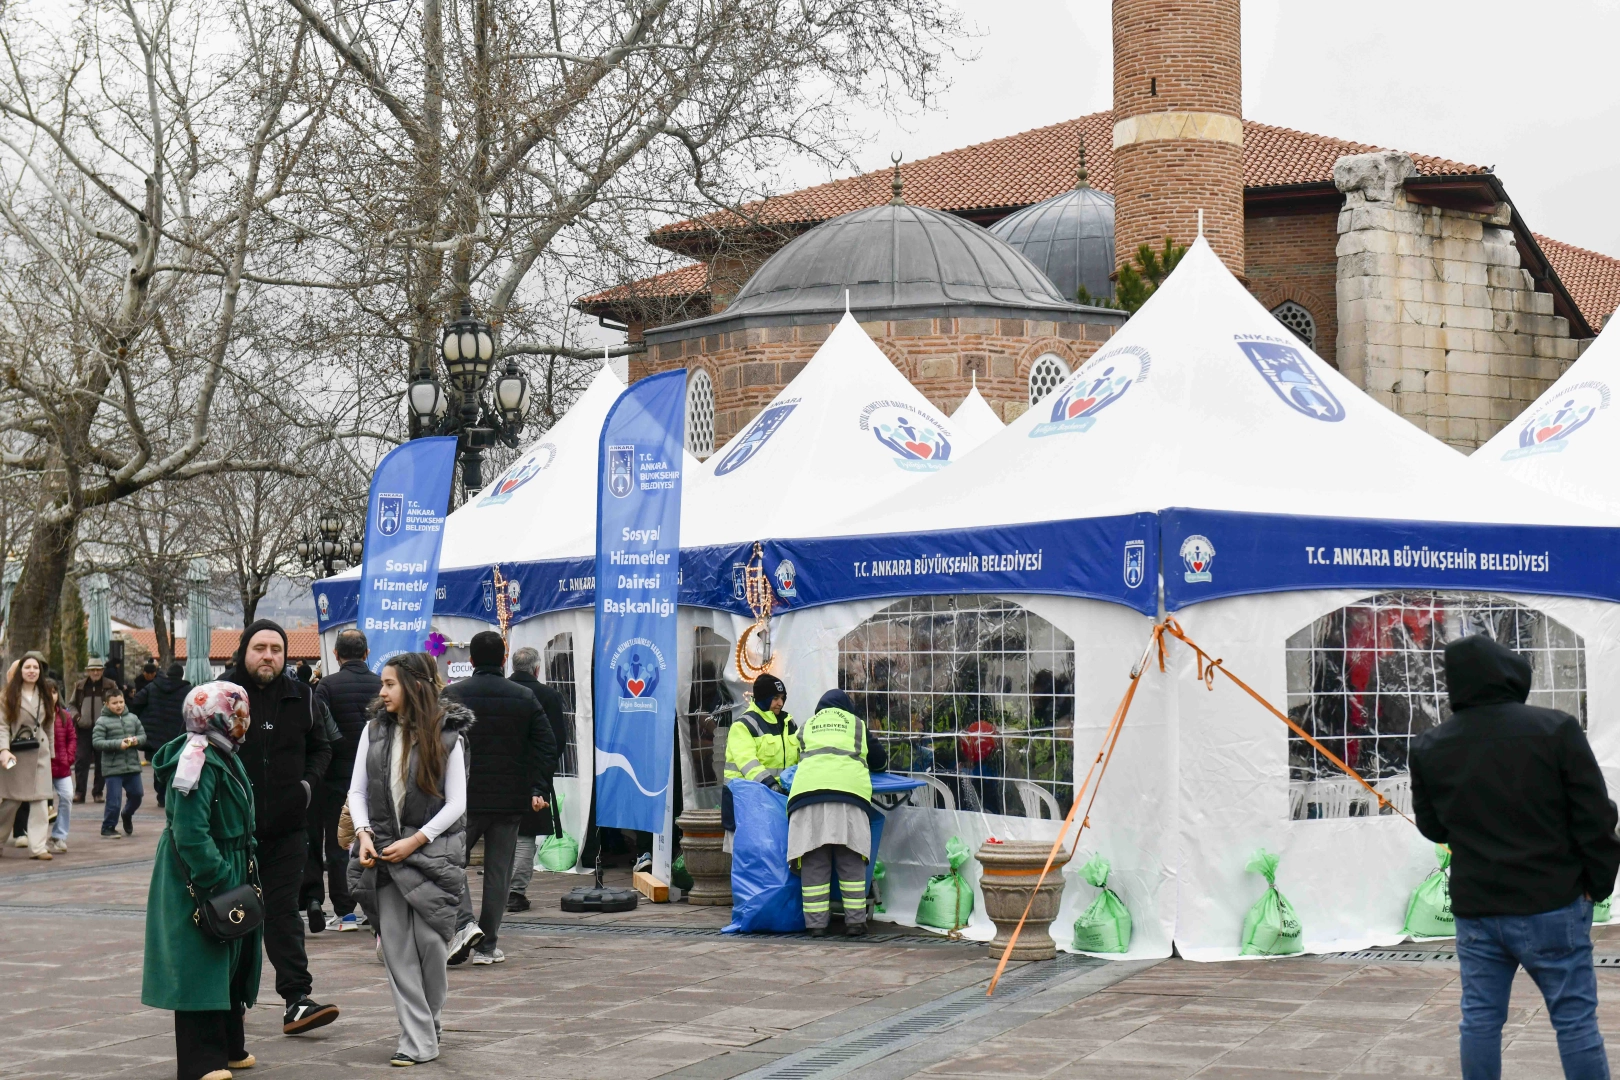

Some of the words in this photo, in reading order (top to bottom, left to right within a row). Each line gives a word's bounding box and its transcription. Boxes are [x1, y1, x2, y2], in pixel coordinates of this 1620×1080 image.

[1233, 334, 1293, 346] ANKARA
[769, 397, 802, 409] ANKARA
[639, 453, 654, 461] T.C.
[640, 462, 667, 471] ANKARA
[407, 500, 420, 508] T.C.
[622, 525, 660, 544] Sosyal
[610, 550, 670, 565] Hizmetler
[854, 562, 869, 577] T.C.
[871, 559, 911, 577] ANKARA
[914, 552, 979, 575] BÜYÜKŞEHİR
[982, 549, 1042, 572] BELEDİYESİ
[1306, 546, 1330, 565] T.C.
[1333, 548, 1390, 566] ANKARA
[1394, 546, 1477, 571] BÜYÜKŞEHİR
[1480, 551, 1549, 572] BELEDİYESİ
[385, 560, 427, 575] Sosyal
[569, 576, 595, 591] ANKARA
[617, 574, 660, 589] Dairesi
[604, 598, 674, 617] Başkanlığı
